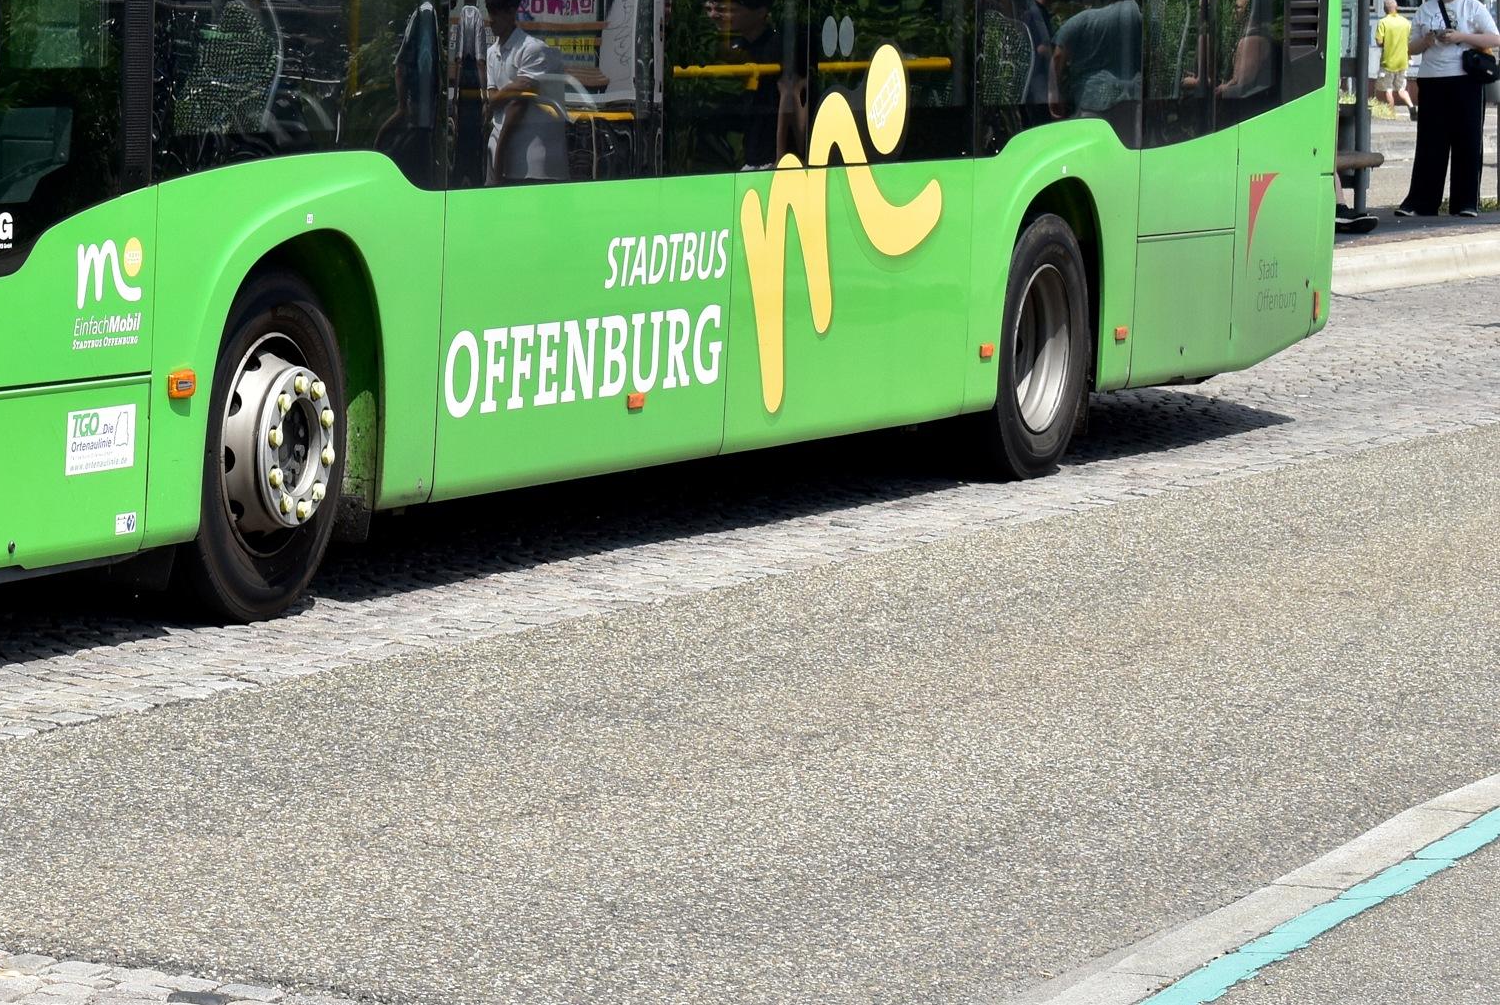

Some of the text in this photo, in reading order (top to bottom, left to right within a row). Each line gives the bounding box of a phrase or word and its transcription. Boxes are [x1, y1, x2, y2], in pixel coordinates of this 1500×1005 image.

[604, 228, 729, 290] STADTBUS
[1258, 258, 1278, 280] Stadt
[1257, 289, 1297, 313] Offenburg
[444, 304, 722, 418] OFFENBURG
[72, 412, 114, 438] TGO Die
[71, 437, 112, 453] Ortenaulinie
